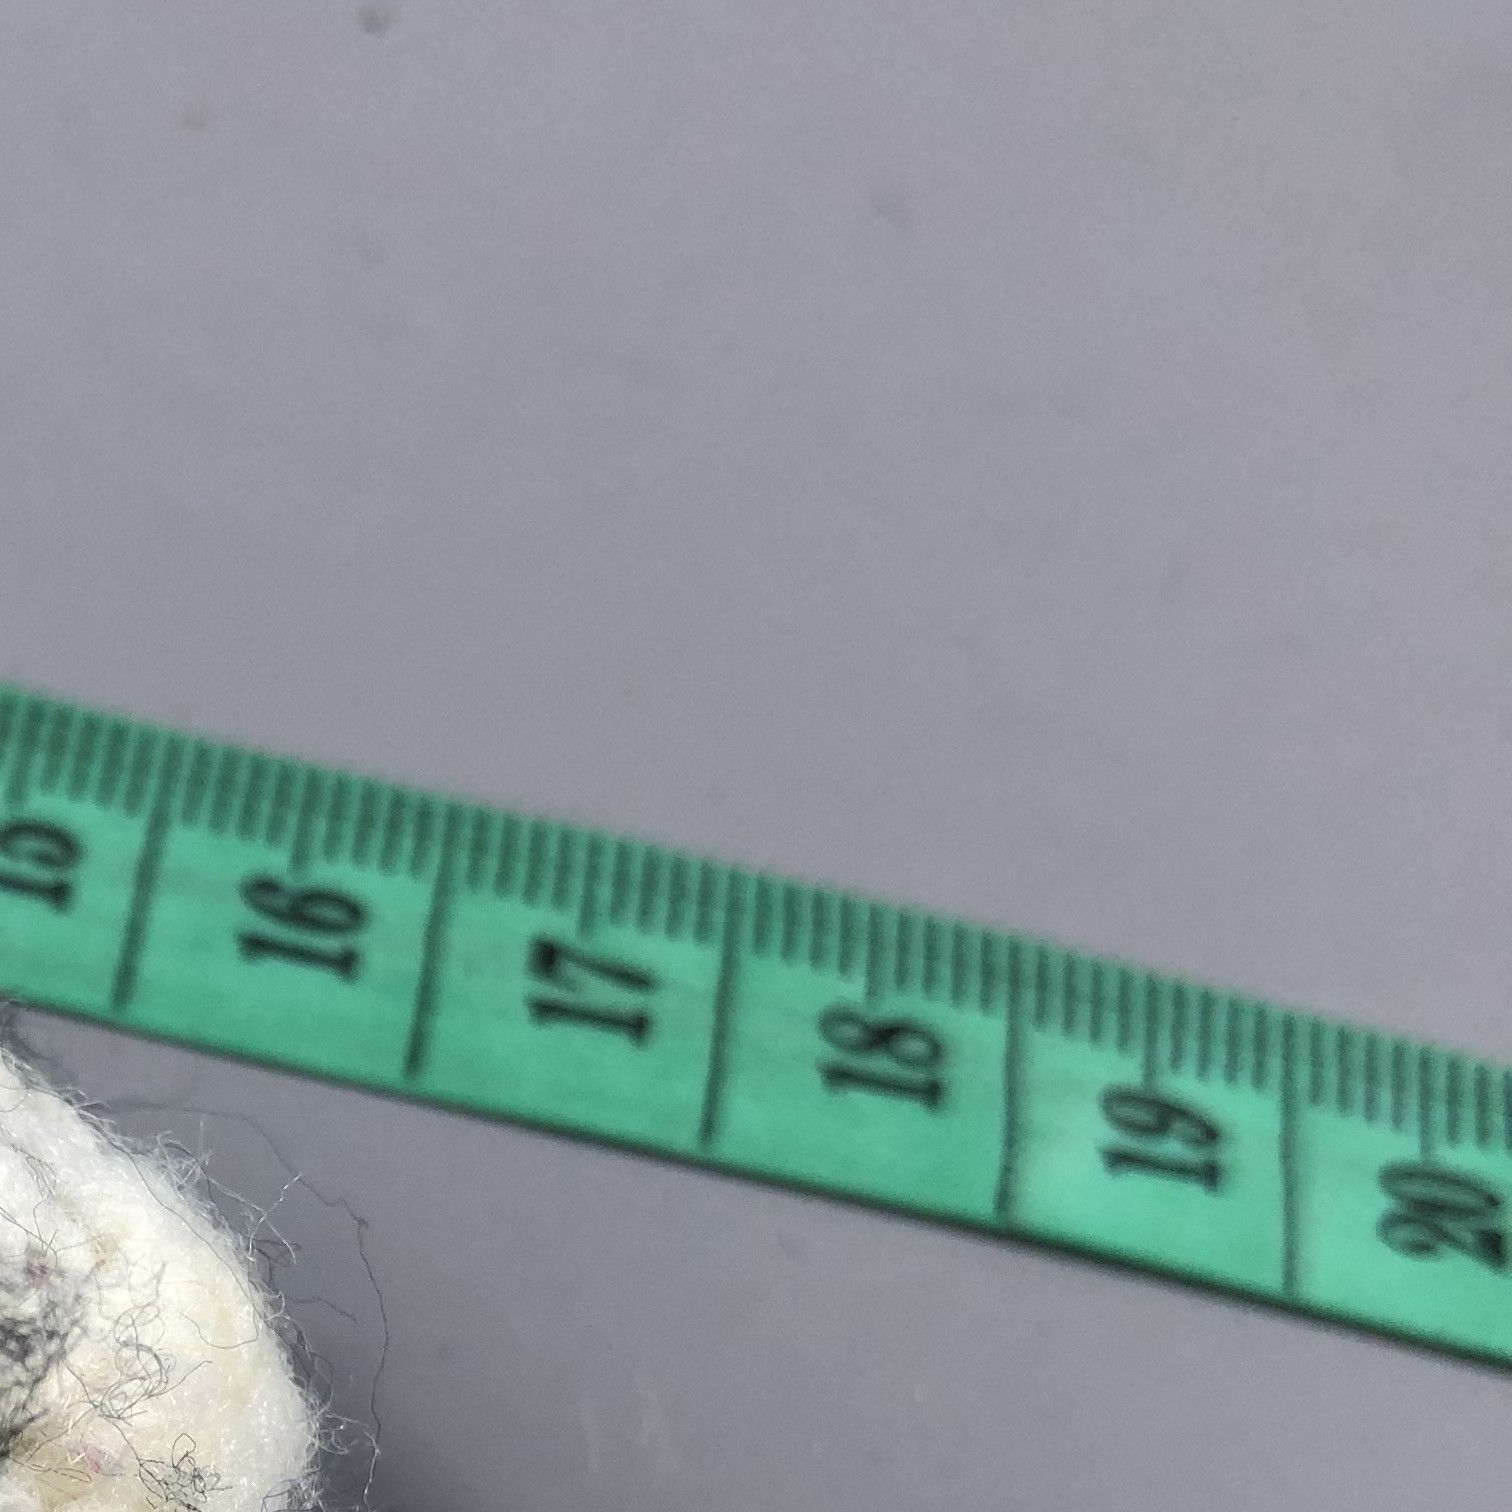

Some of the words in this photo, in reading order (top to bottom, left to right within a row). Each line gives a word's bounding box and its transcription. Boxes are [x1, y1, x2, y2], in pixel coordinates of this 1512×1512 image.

[235, 873, 369, 982] 16
[524, 931, 660, 1048] 17
[817, 1003, 948, 1114] 18
[1097, 1082, 1224, 1193] 19
[1376, 1160, 1510, 1274] 20
